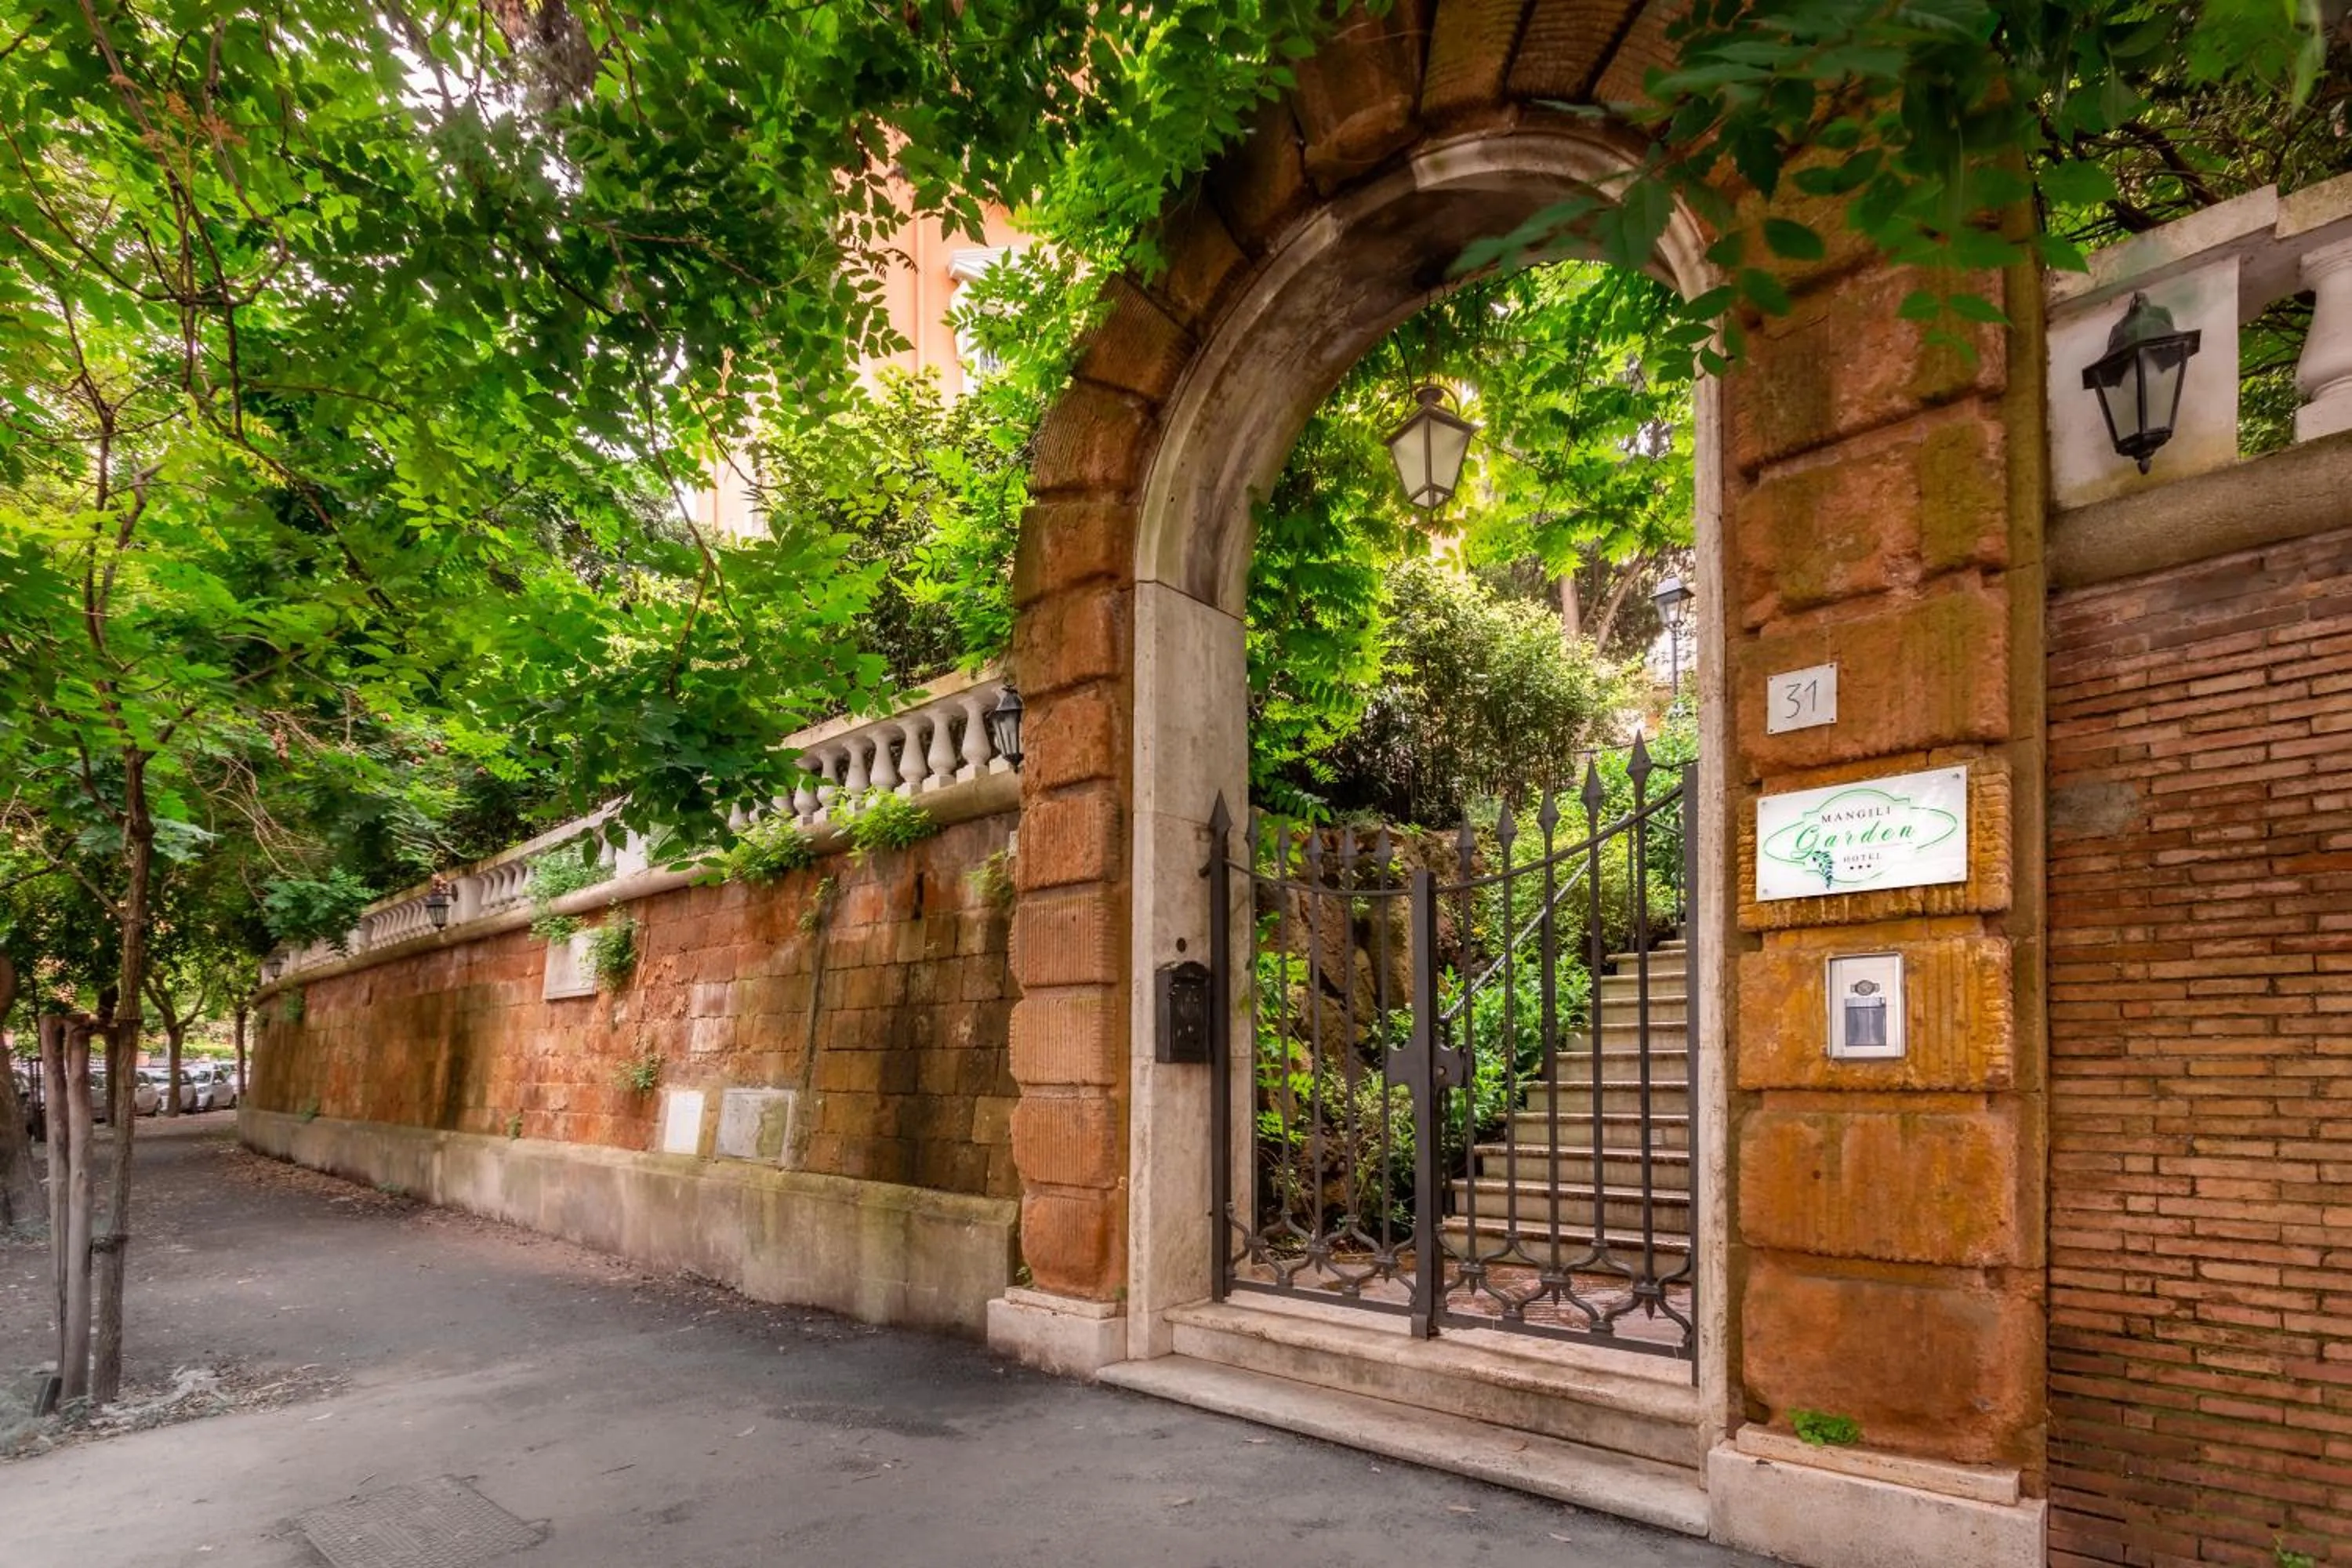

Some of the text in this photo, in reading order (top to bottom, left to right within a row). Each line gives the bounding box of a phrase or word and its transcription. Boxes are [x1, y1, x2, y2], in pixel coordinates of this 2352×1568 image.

[1785, 679, 1817, 719] 31
[1821, 806, 1891, 824] MANGILI
[1791, 821, 1915, 859] Garden
[1843, 852, 1882, 863] HOTEL
